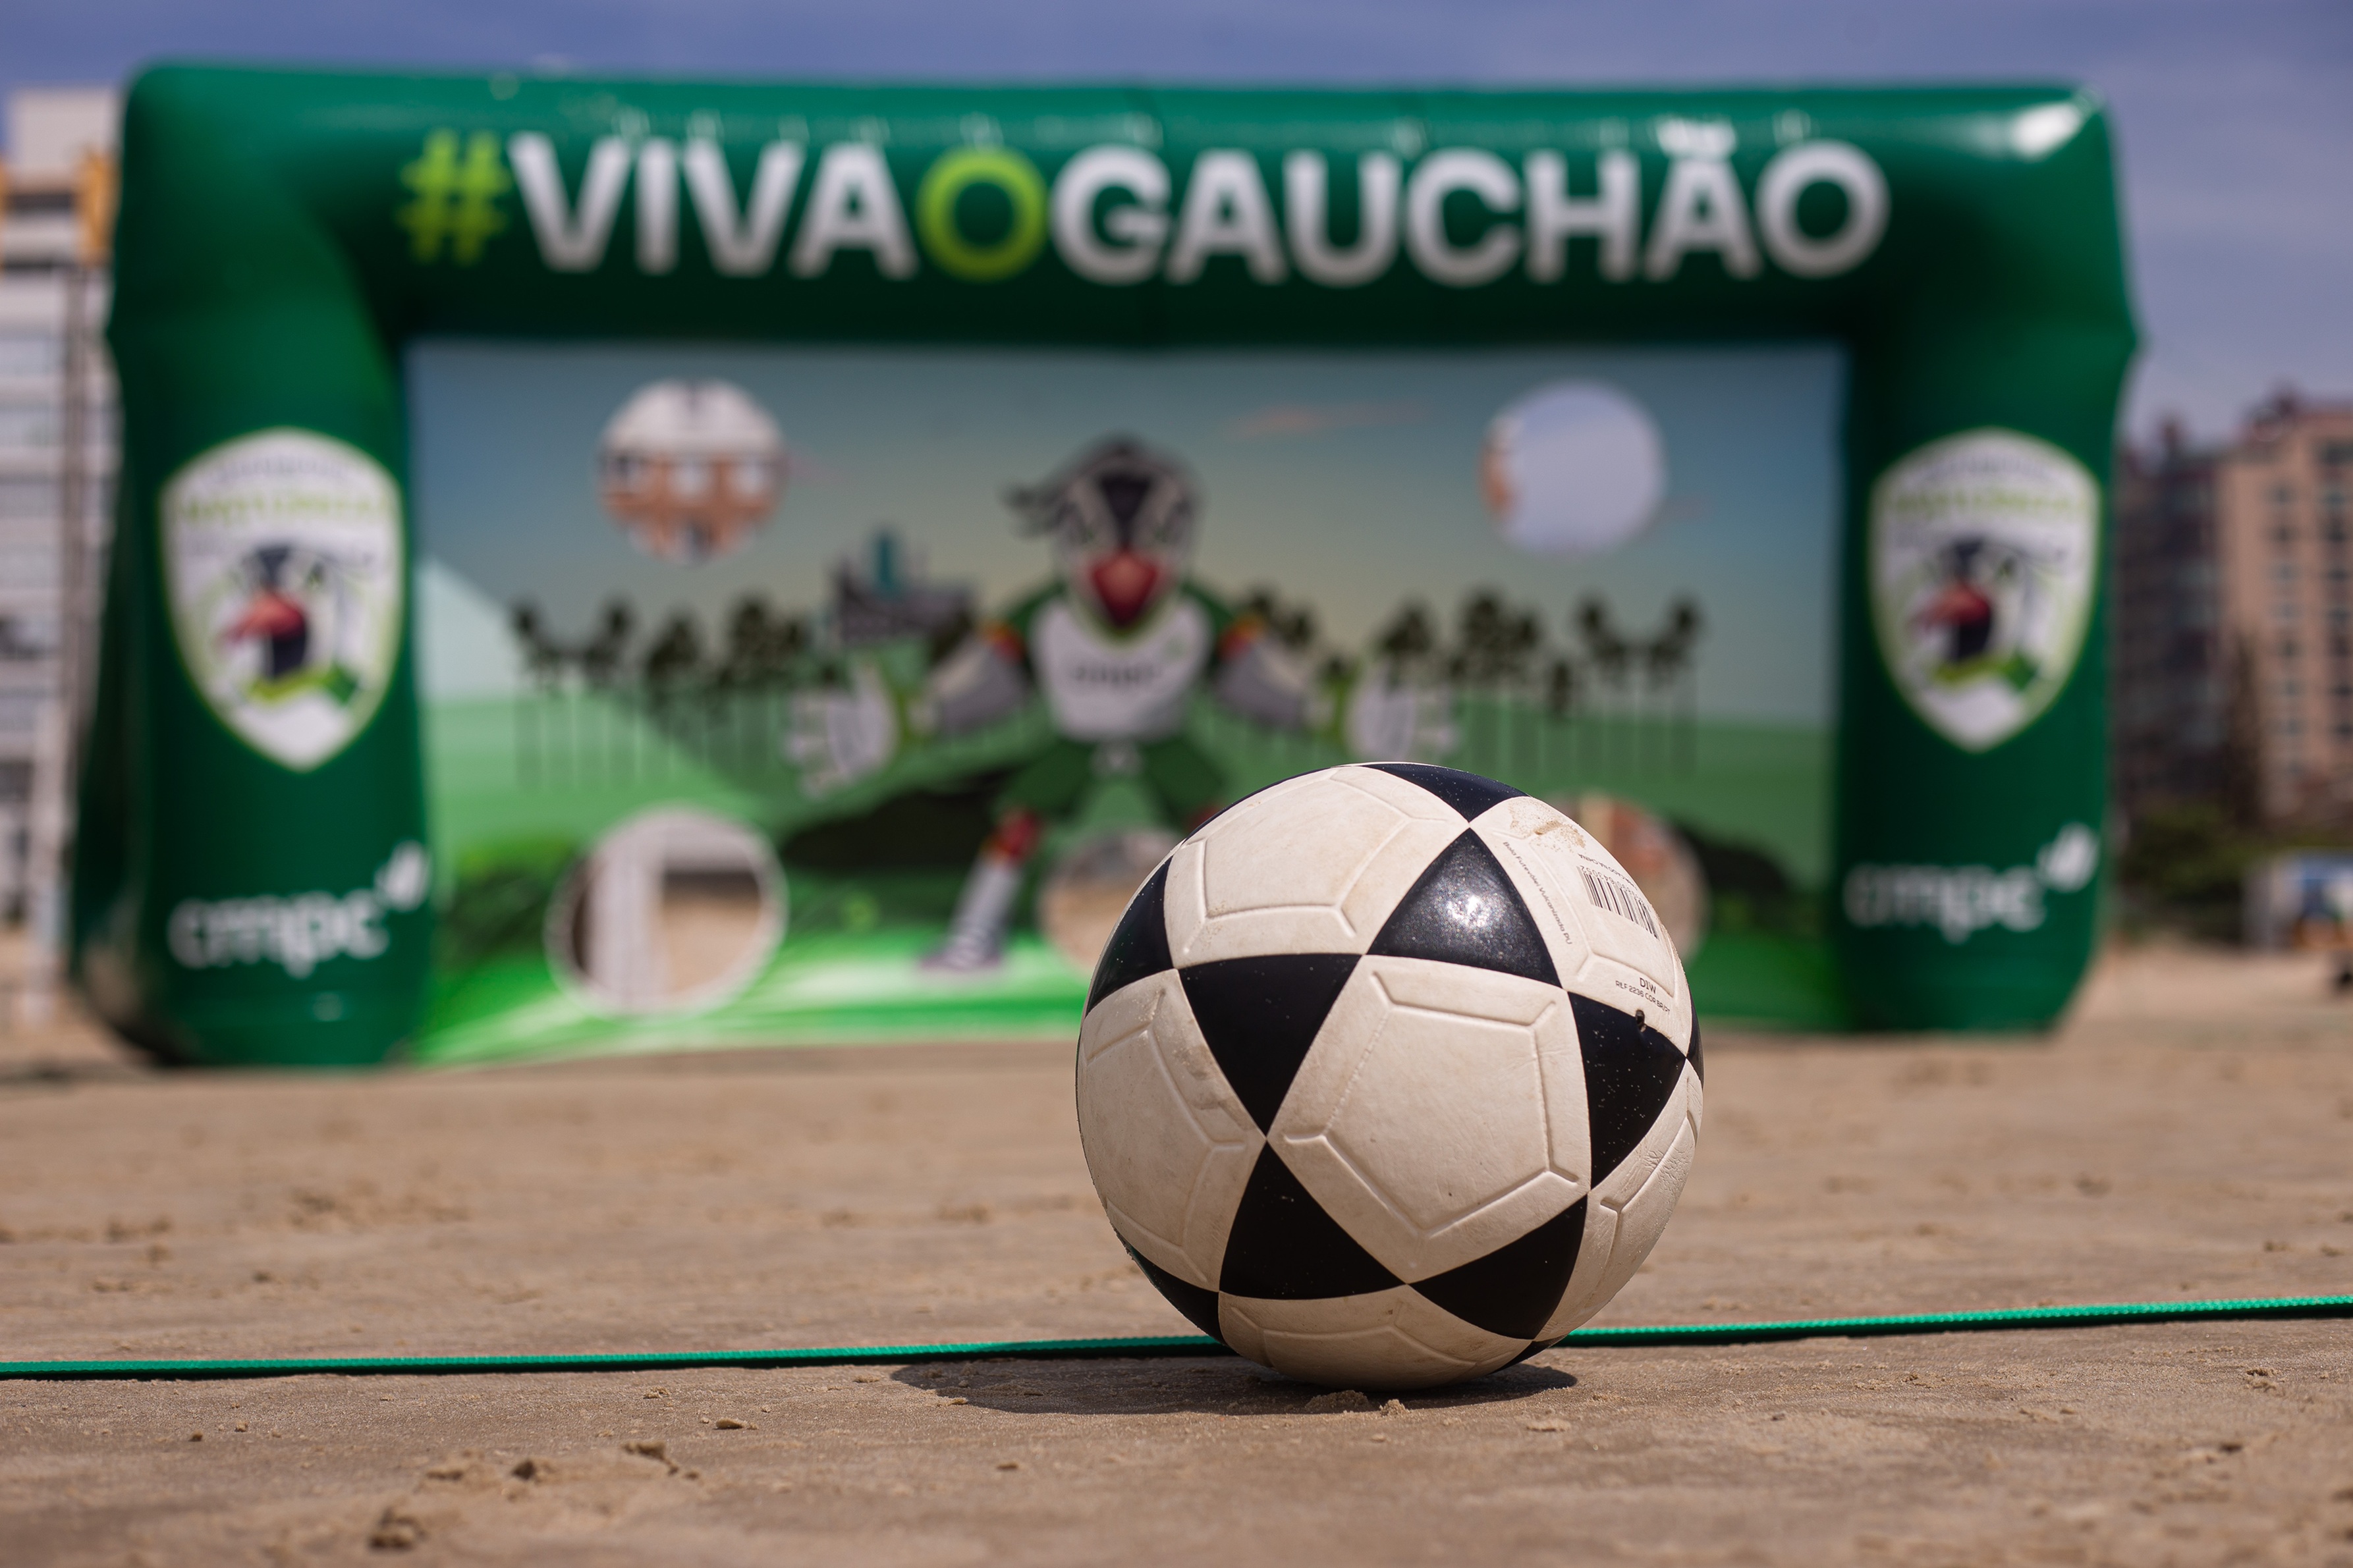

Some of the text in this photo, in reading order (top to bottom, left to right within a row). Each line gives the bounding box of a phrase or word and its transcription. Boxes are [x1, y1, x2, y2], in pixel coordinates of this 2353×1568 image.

[1503, 842, 1517, 856] Bola
[1539, 887, 1565, 932] Vulcanizada
[1563, 933, 1573, 944] PU
[1628, 985, 1644, 997] 2236
[1645, 992, 1657, 1003] COR
